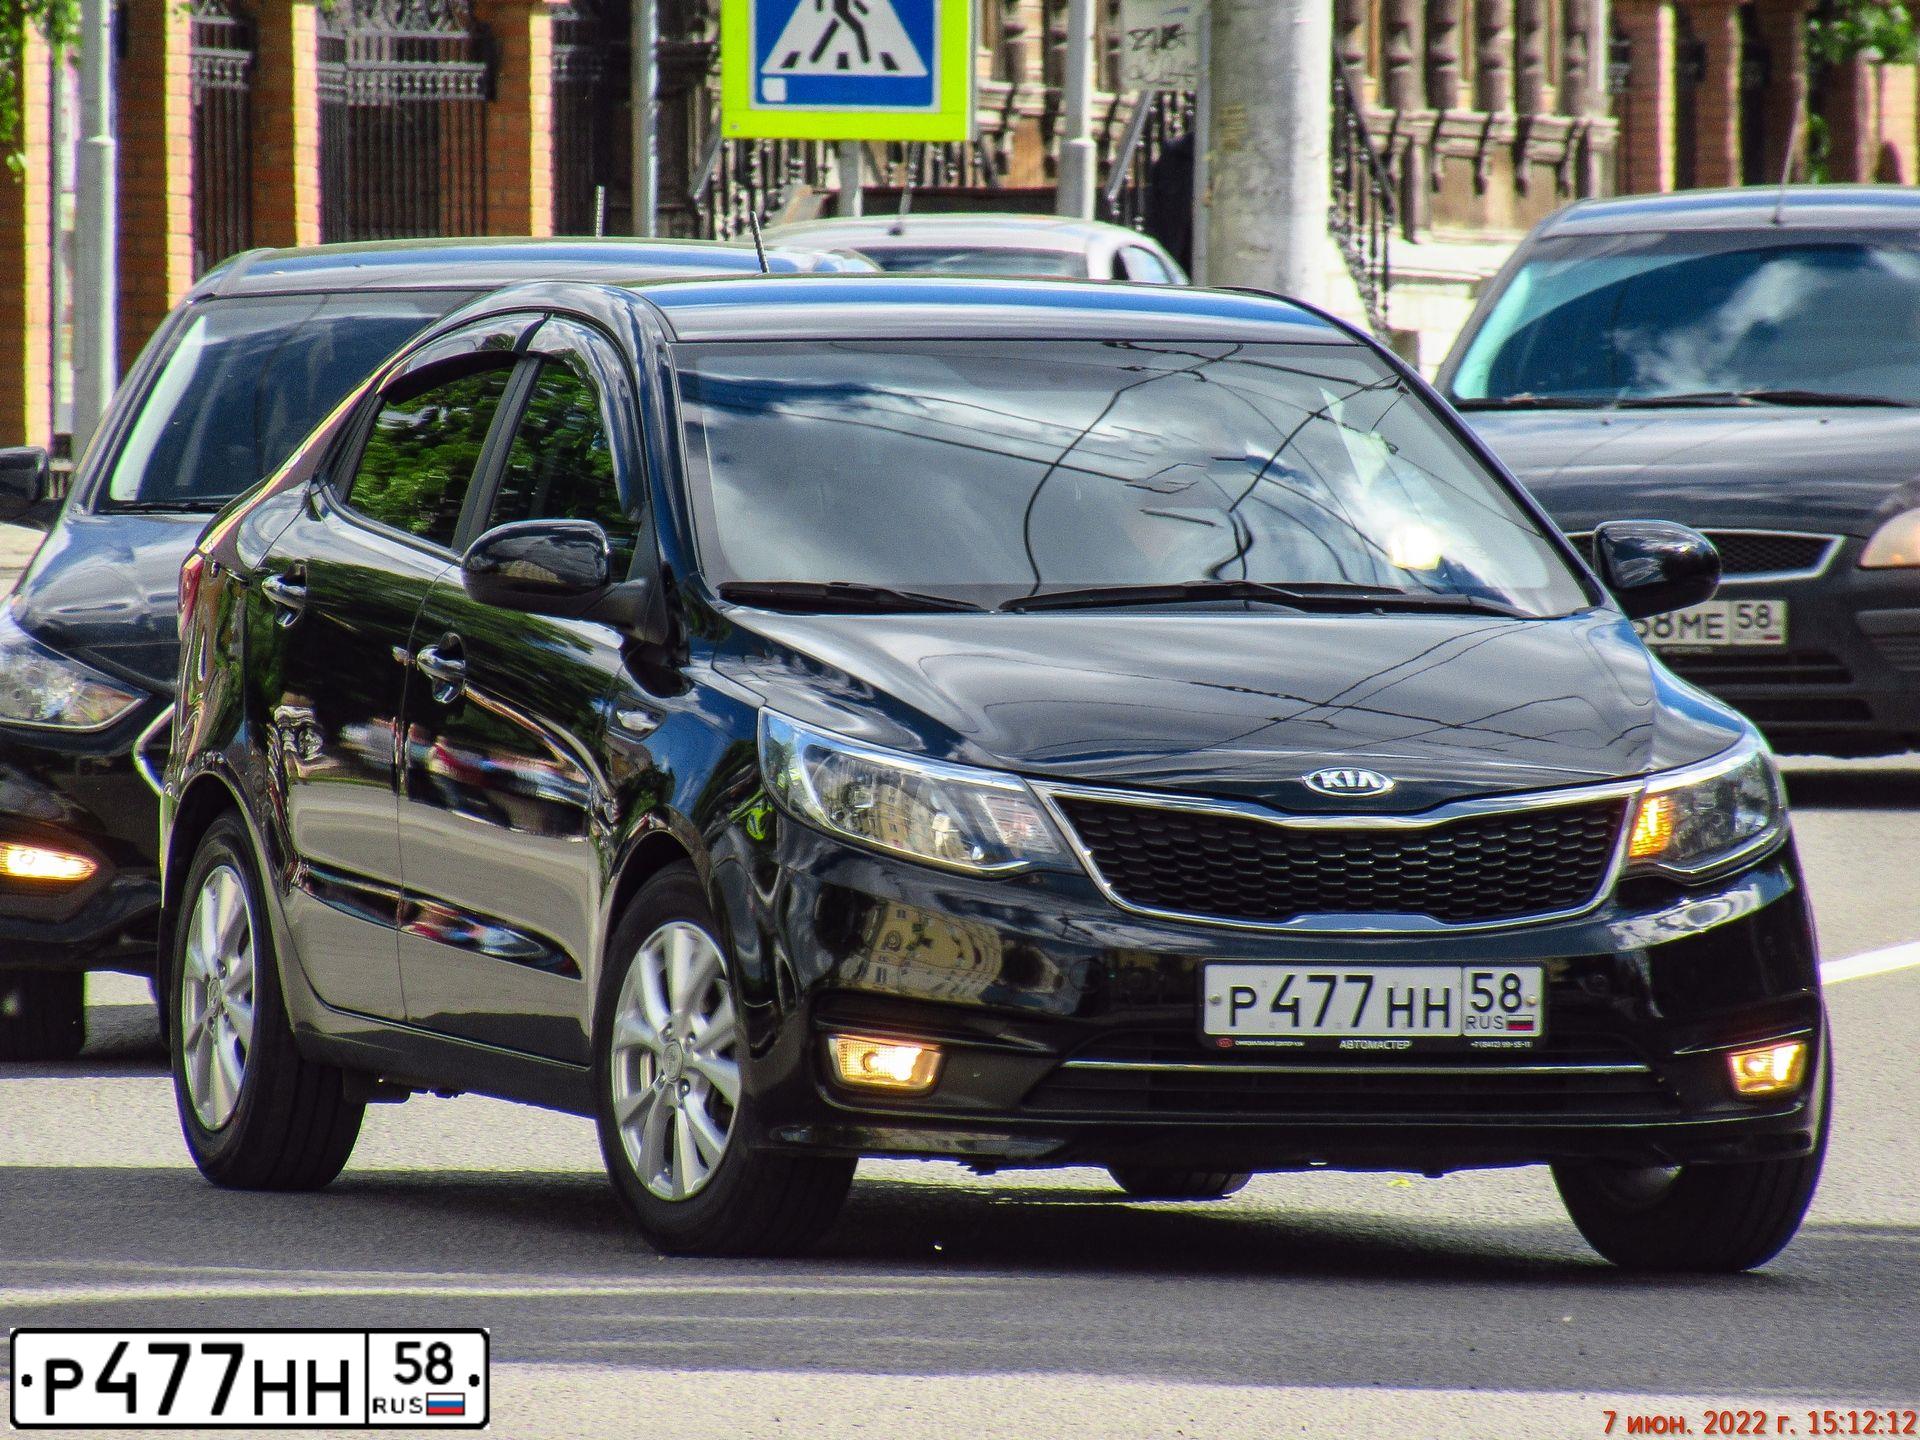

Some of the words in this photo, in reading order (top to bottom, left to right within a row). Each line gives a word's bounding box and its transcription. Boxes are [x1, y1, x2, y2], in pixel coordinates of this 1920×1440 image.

[1736, 603, 1773, 630] 58
[1317, 770, 1382, 789] KIA
[1469, 972, 1523, 1013] 58
[1465, 1015, 1504, 1030] RUS
